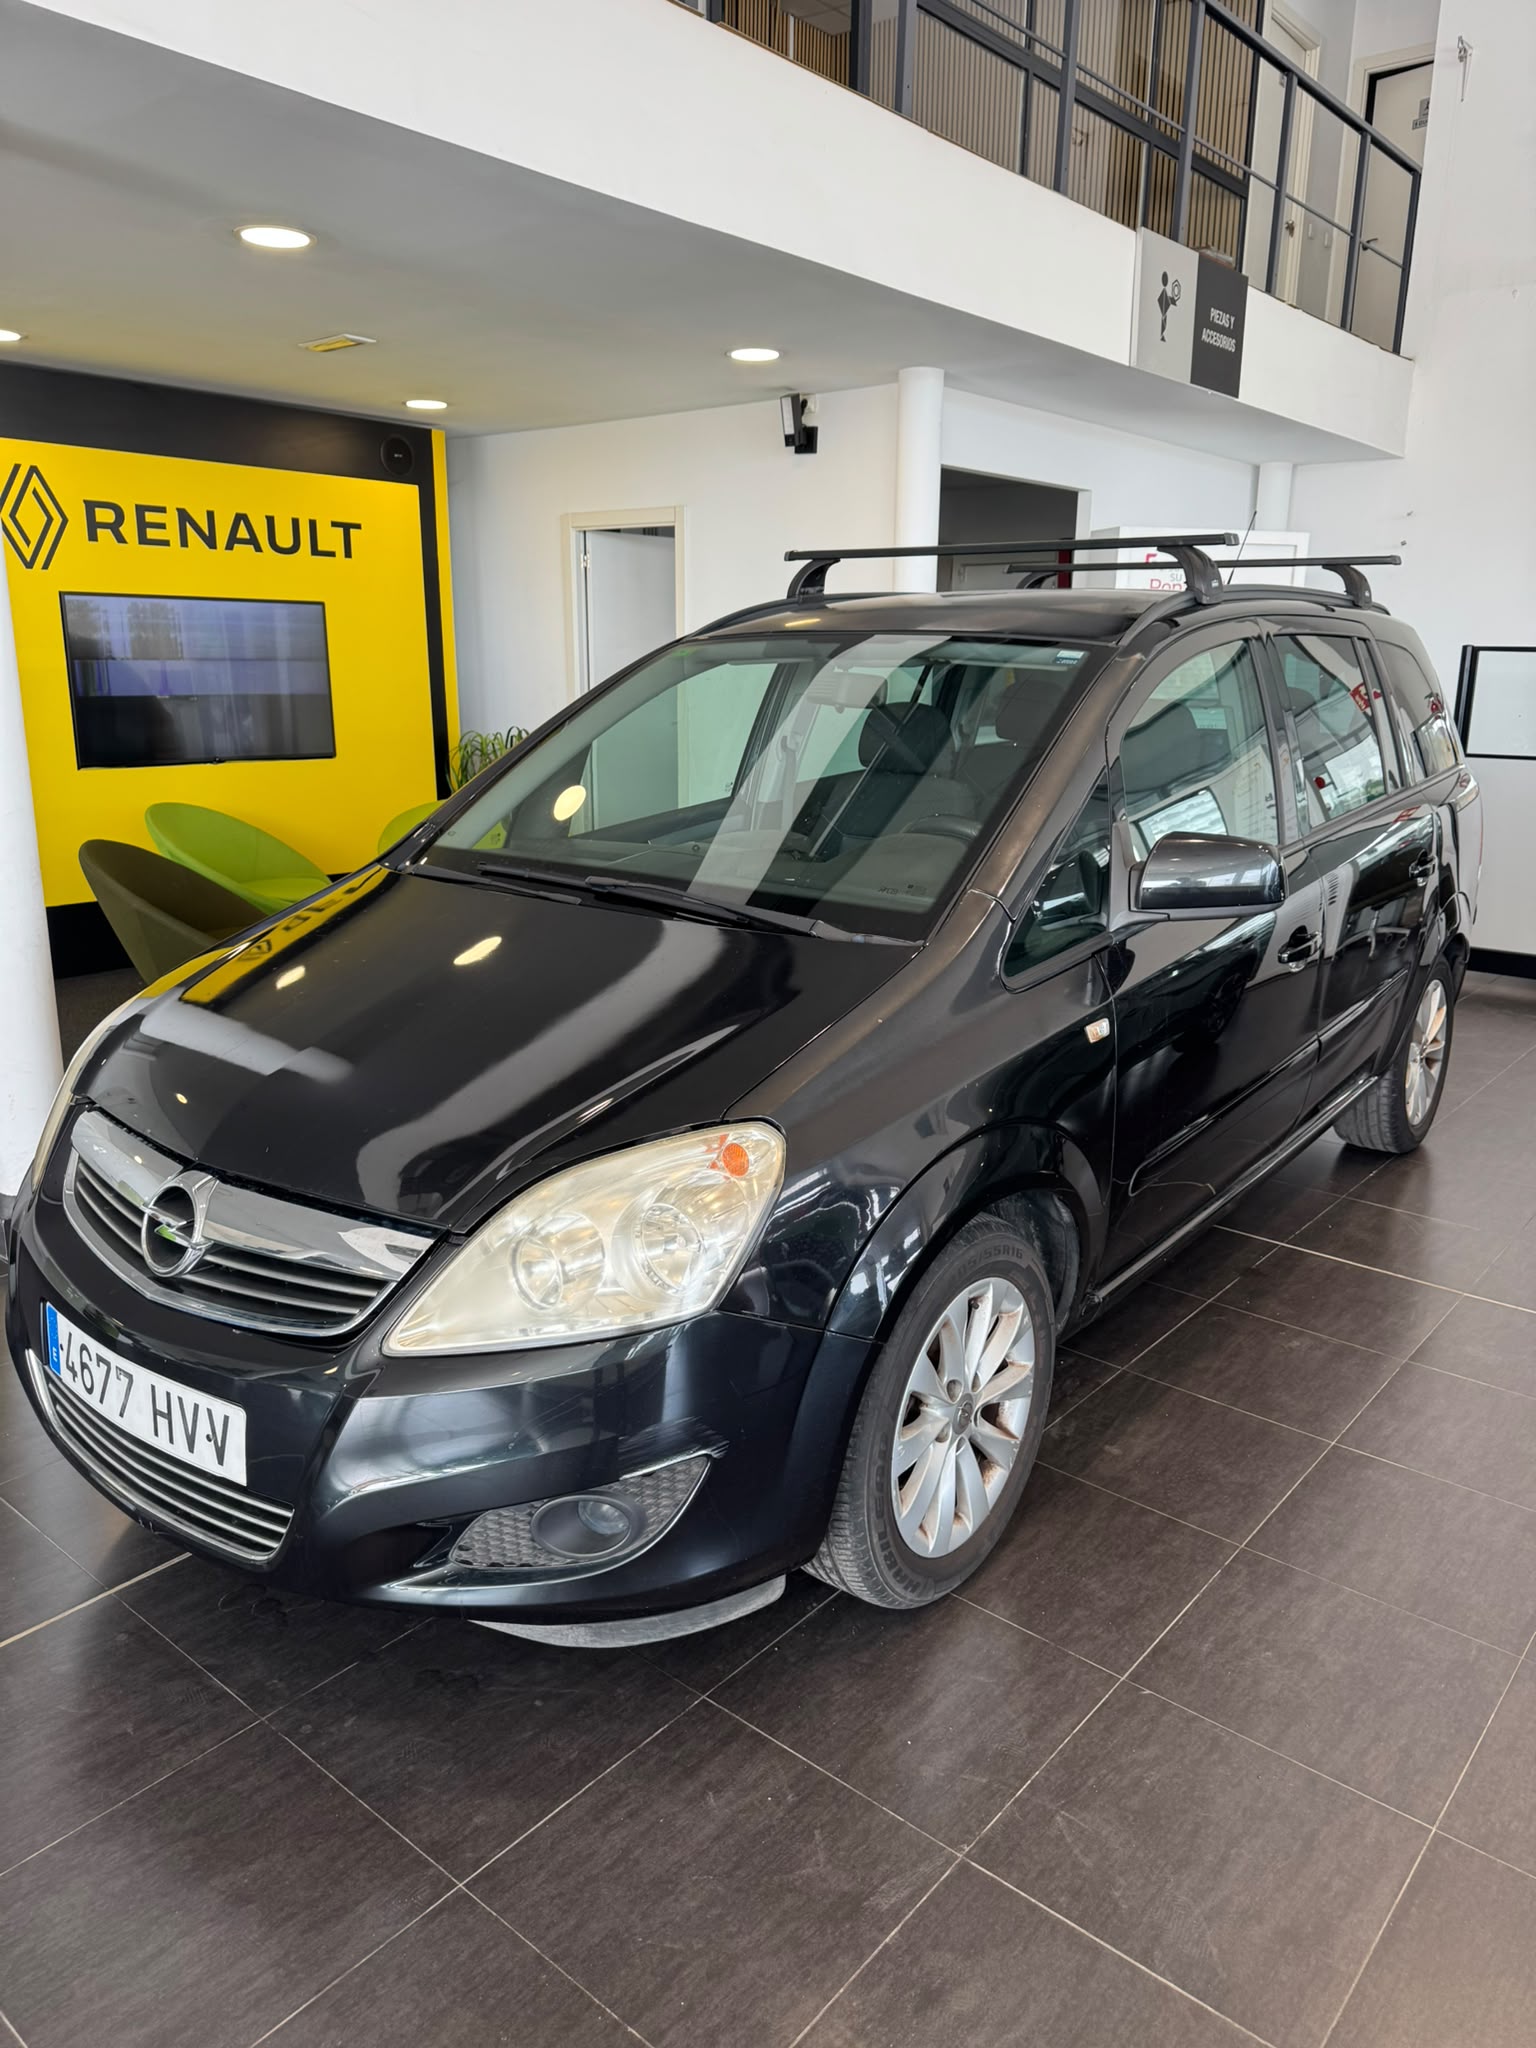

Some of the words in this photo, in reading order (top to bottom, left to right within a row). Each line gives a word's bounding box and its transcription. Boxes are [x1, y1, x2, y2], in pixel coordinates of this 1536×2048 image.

[1201, 327, 1237, 353] ACCESORIOS
[1209, 307, 1230, 328] PIEZAS
[1230, 315, 1236, 330] Y
[82, 498, 363, 559] RENAULT
[65, 1331, 135, 1419] 4677
[150, 1383, 230, 1467] HVV
